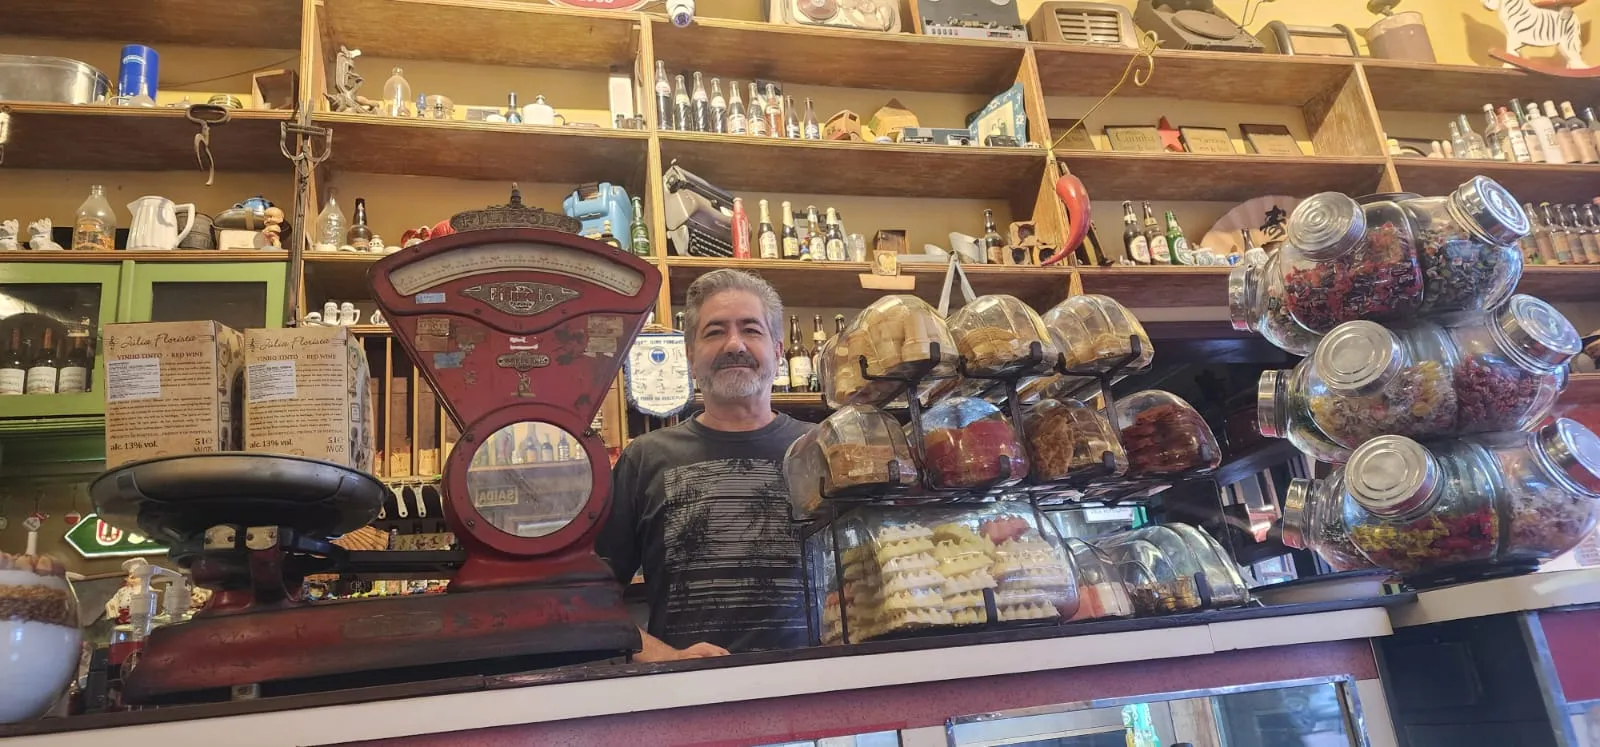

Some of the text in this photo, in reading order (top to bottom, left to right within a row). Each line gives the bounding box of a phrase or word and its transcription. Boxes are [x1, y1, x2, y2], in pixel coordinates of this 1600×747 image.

[125, 441, 143, 450] 13%
[144, 440, 158, 448] vol.
[263, 440, 279, 448] 13%
